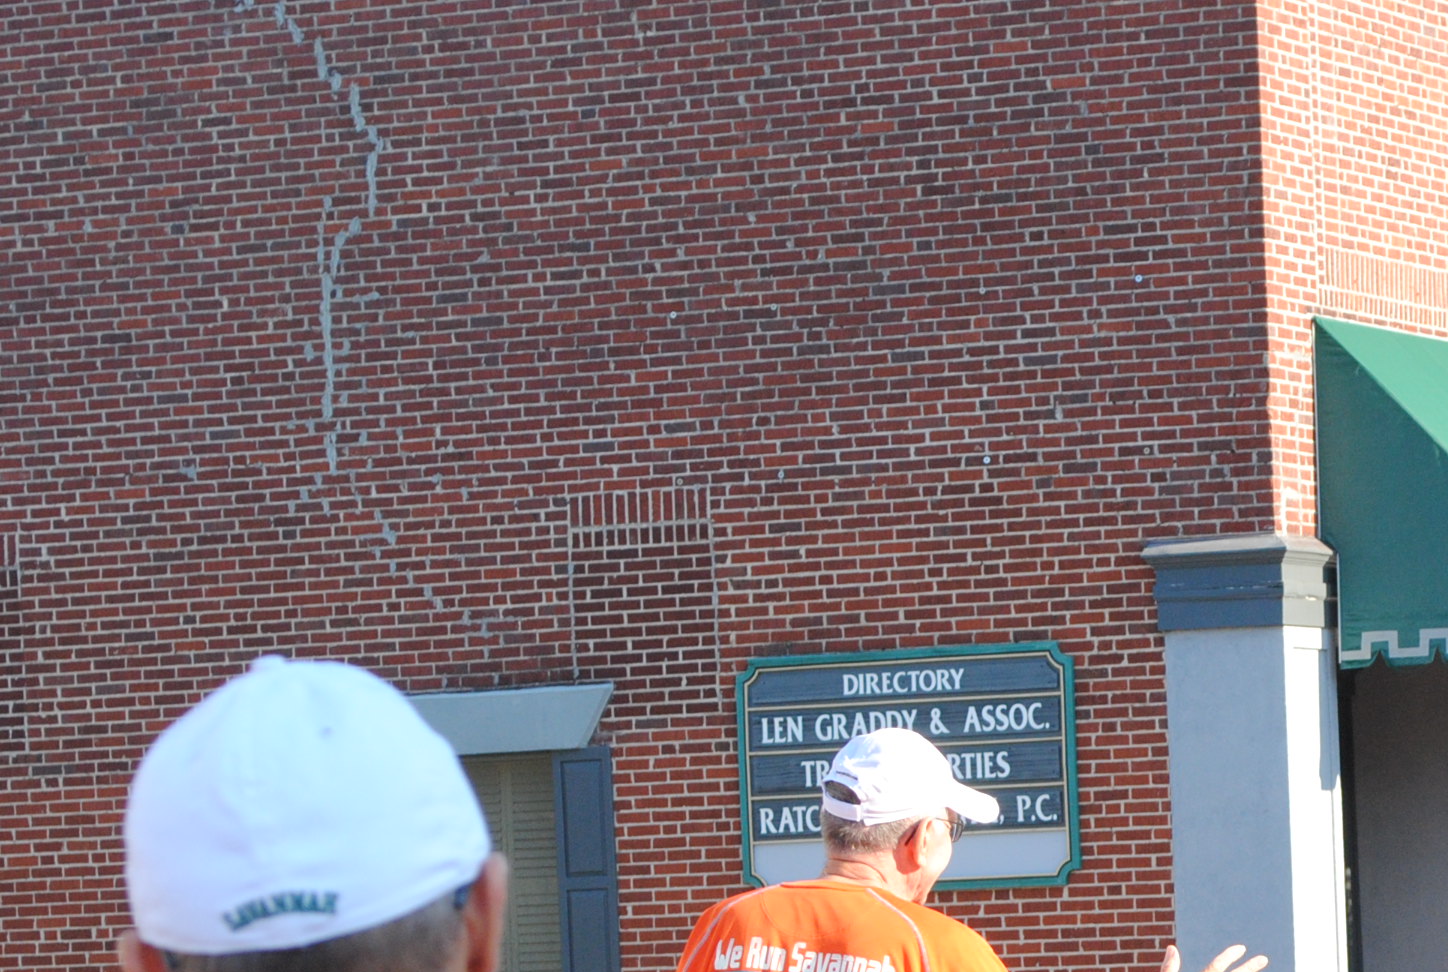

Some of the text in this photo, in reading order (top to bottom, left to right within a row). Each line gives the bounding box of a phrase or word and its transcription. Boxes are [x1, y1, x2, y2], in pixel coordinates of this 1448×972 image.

[843, 668, 964, 695] DIRECTORY
[761, 702, 1050, 744] LEN GRADDY & ASSOC.
[1016, 793, 1058, 822] P.C.
[714, 938, 744, 970] We
[746, 936, 787, 972] Run
